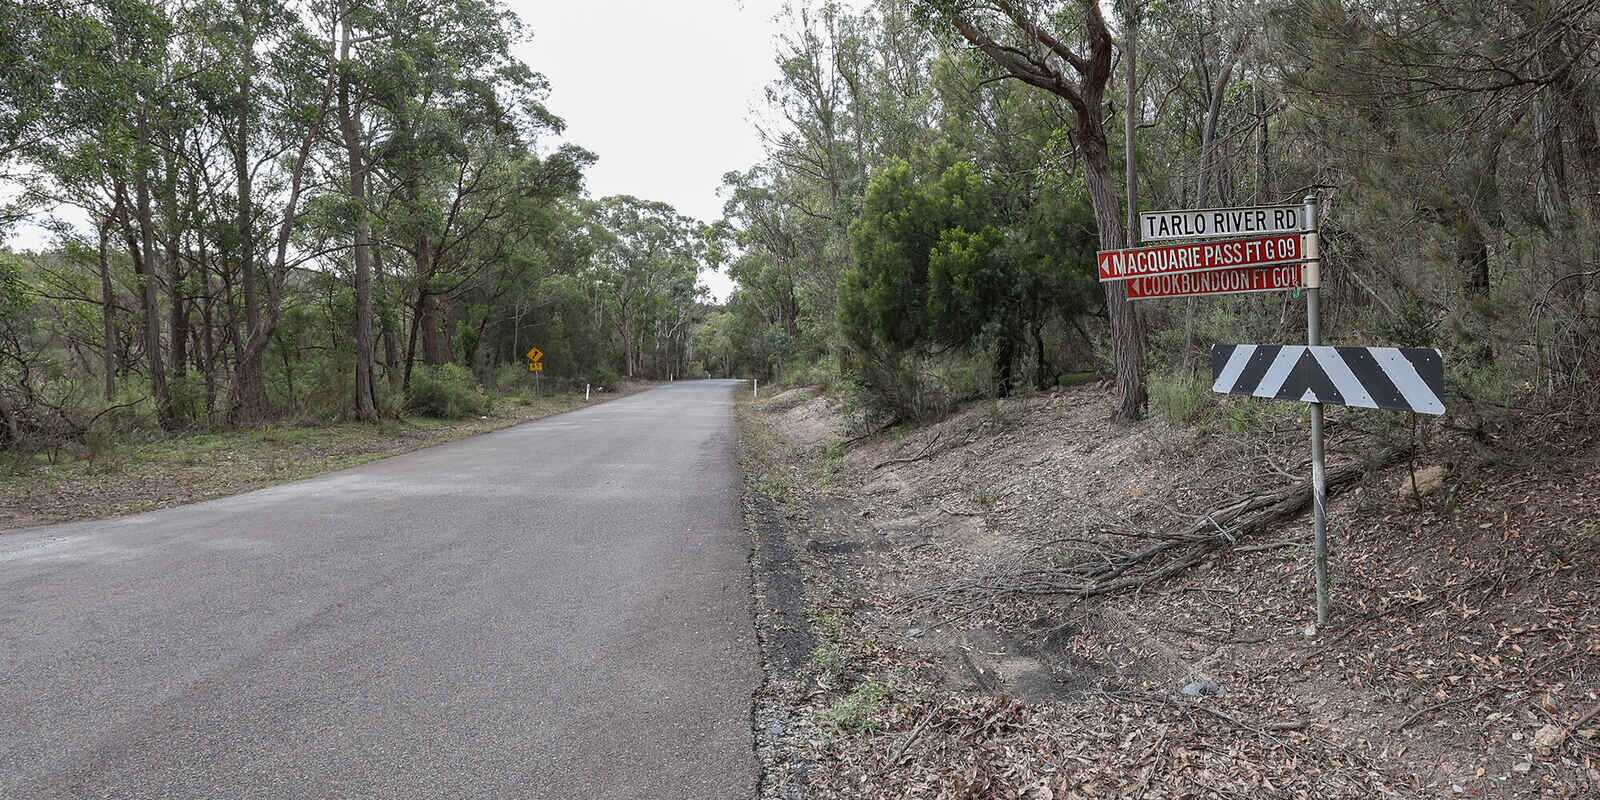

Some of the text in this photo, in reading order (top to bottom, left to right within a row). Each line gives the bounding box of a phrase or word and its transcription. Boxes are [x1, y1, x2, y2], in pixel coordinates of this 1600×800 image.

[1146, 209, 1297, 237] TARLO RIVER RD
[1112, 237, 1296, 275] MACQUARIE PASS FT G 09
[1143, 270, 1250, 296] COOKBUNDOON
[1252, 268, 1268, 289] FT
